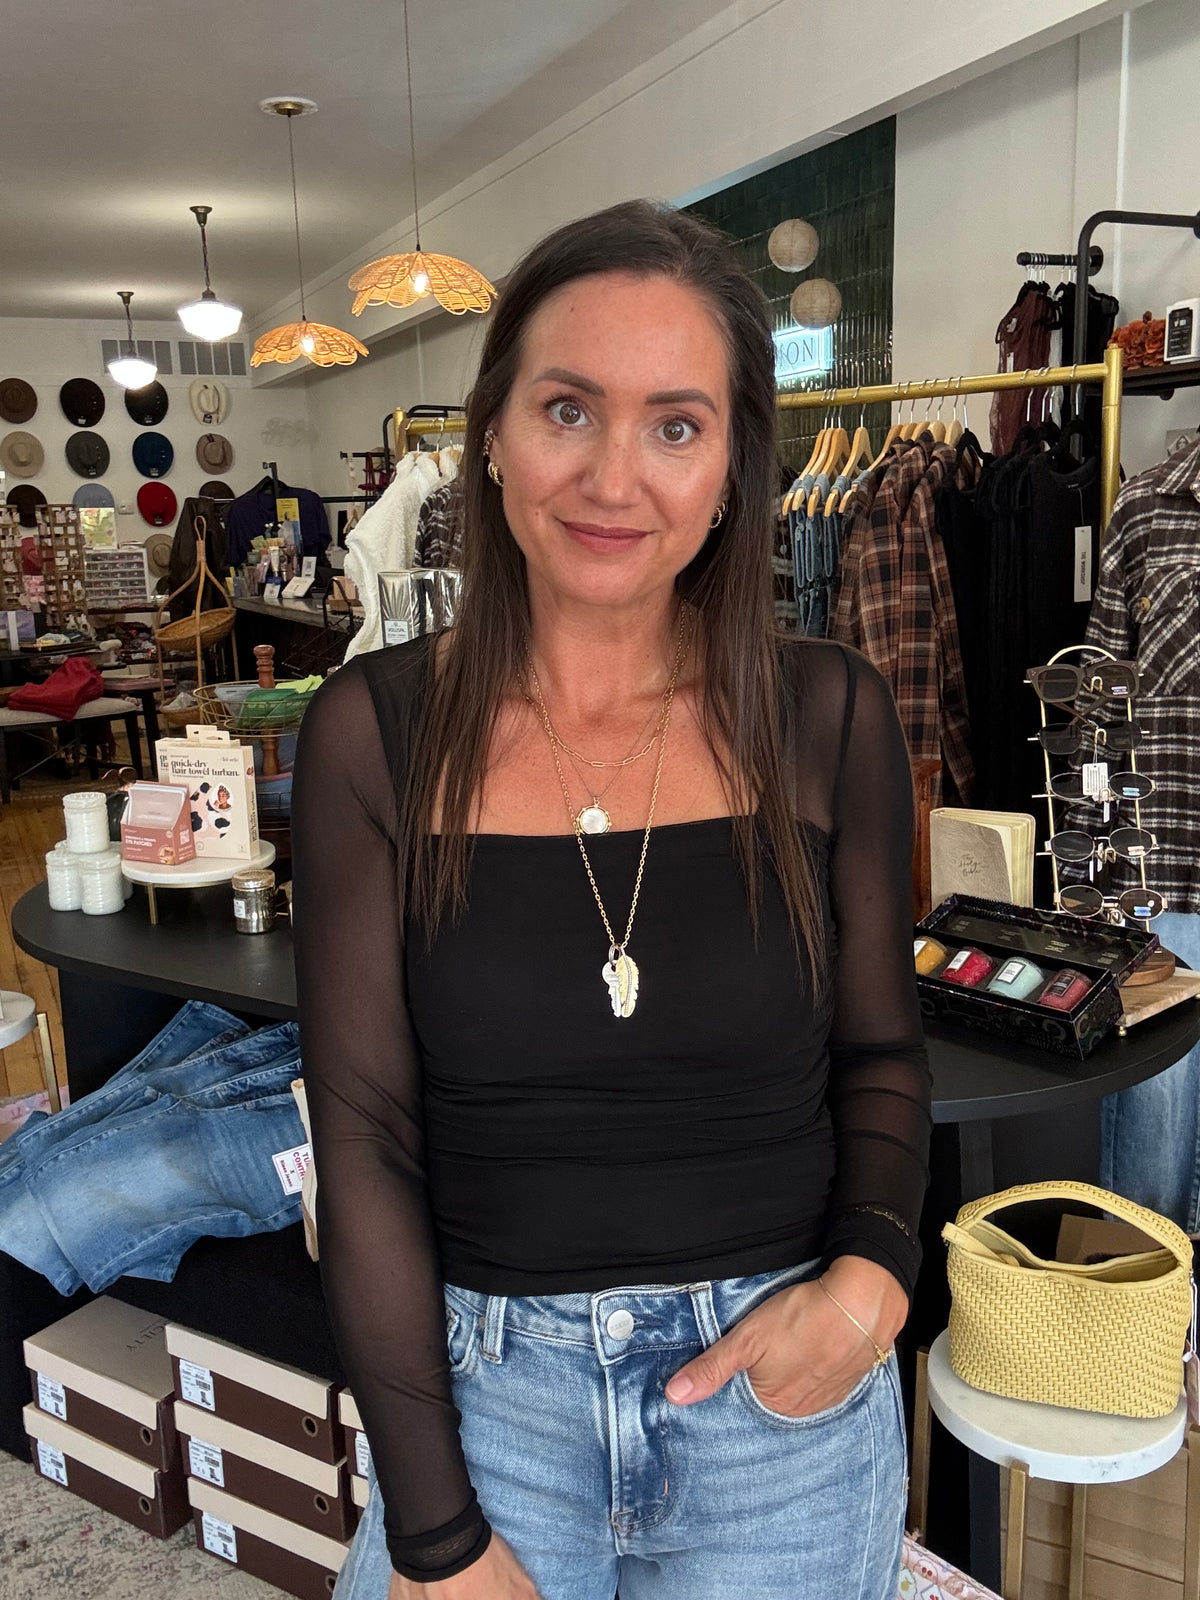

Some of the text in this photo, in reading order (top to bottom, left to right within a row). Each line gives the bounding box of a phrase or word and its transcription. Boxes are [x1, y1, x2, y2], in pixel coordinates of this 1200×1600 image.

[170, 759, 207, 770] quick-dry
[172, 767, 187, 775] hair
[188, 768, 210, 776] towel
